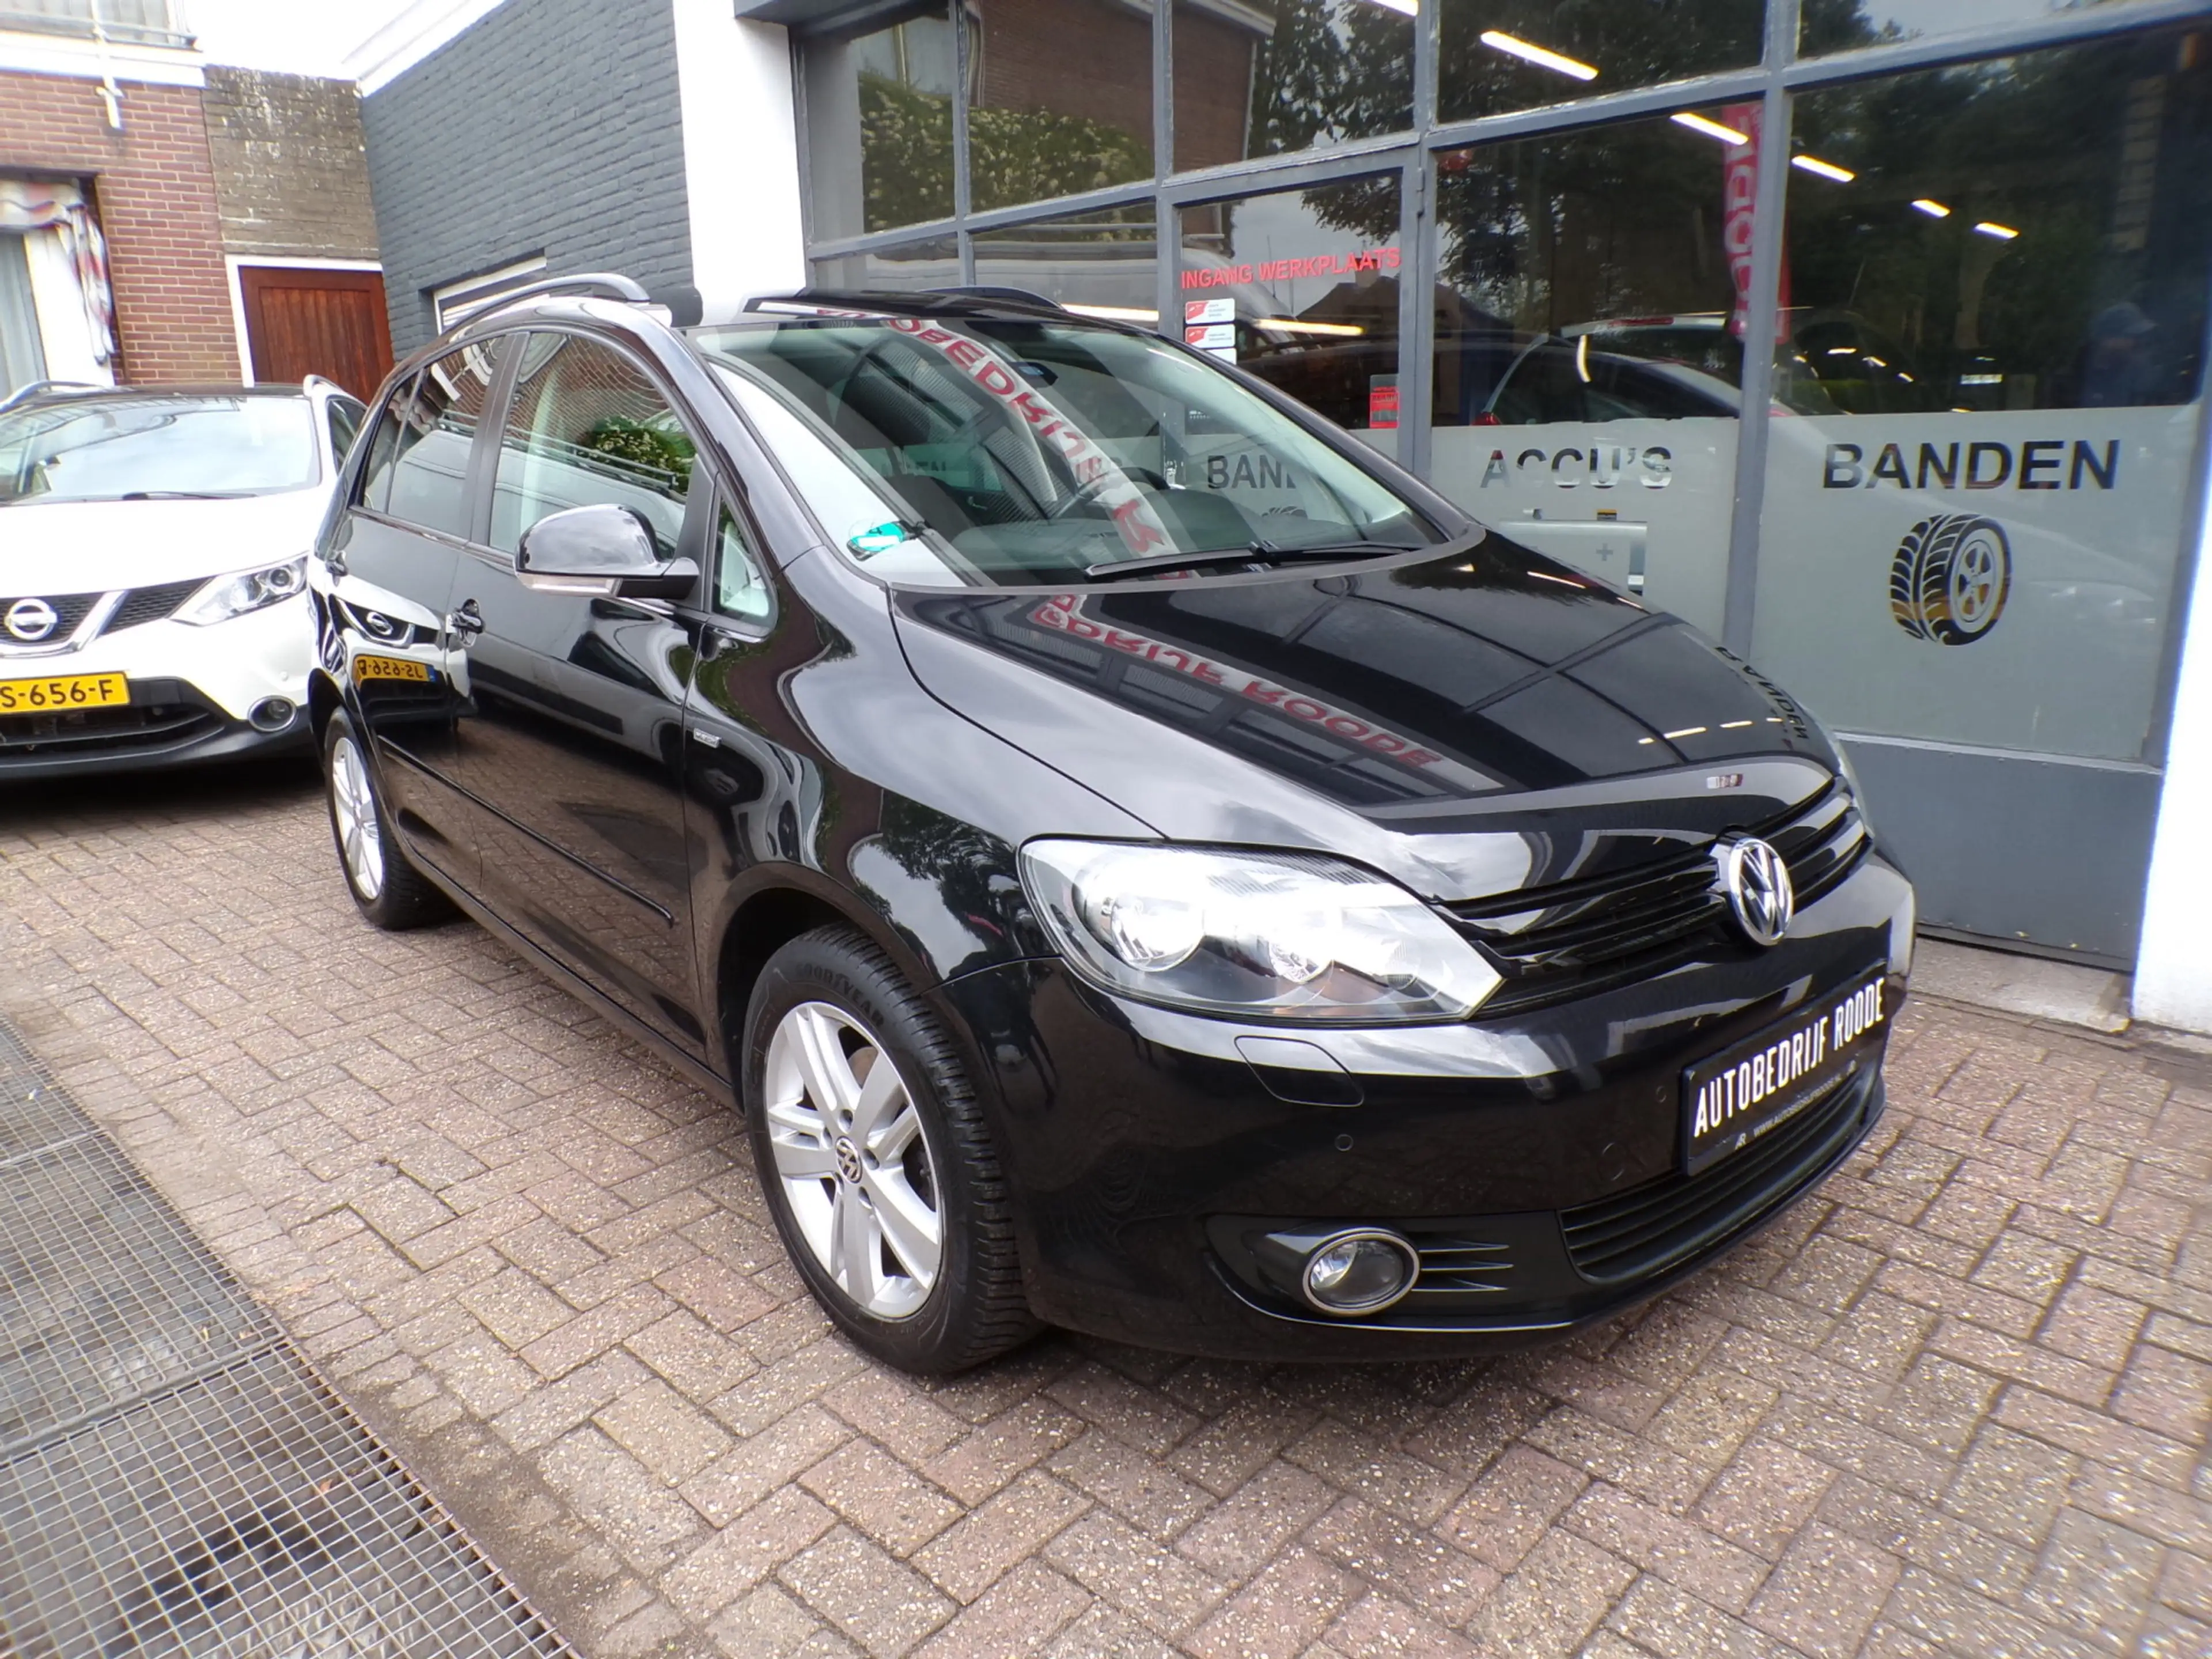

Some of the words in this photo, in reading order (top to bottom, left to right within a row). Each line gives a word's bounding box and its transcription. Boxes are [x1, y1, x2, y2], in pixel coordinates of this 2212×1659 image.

[1181, 264, 1253, 289] INGANG
[1259, 248, 1402, 281] WERKPLAATS
[1823, 440, 2120, 489] BANDEN
[0, 679, 113, 708] S-656-F
[1694, 1016, 1829, 1138] AUTOBEDRIJF
[1834, 977, 1885, 1051] ROODE
